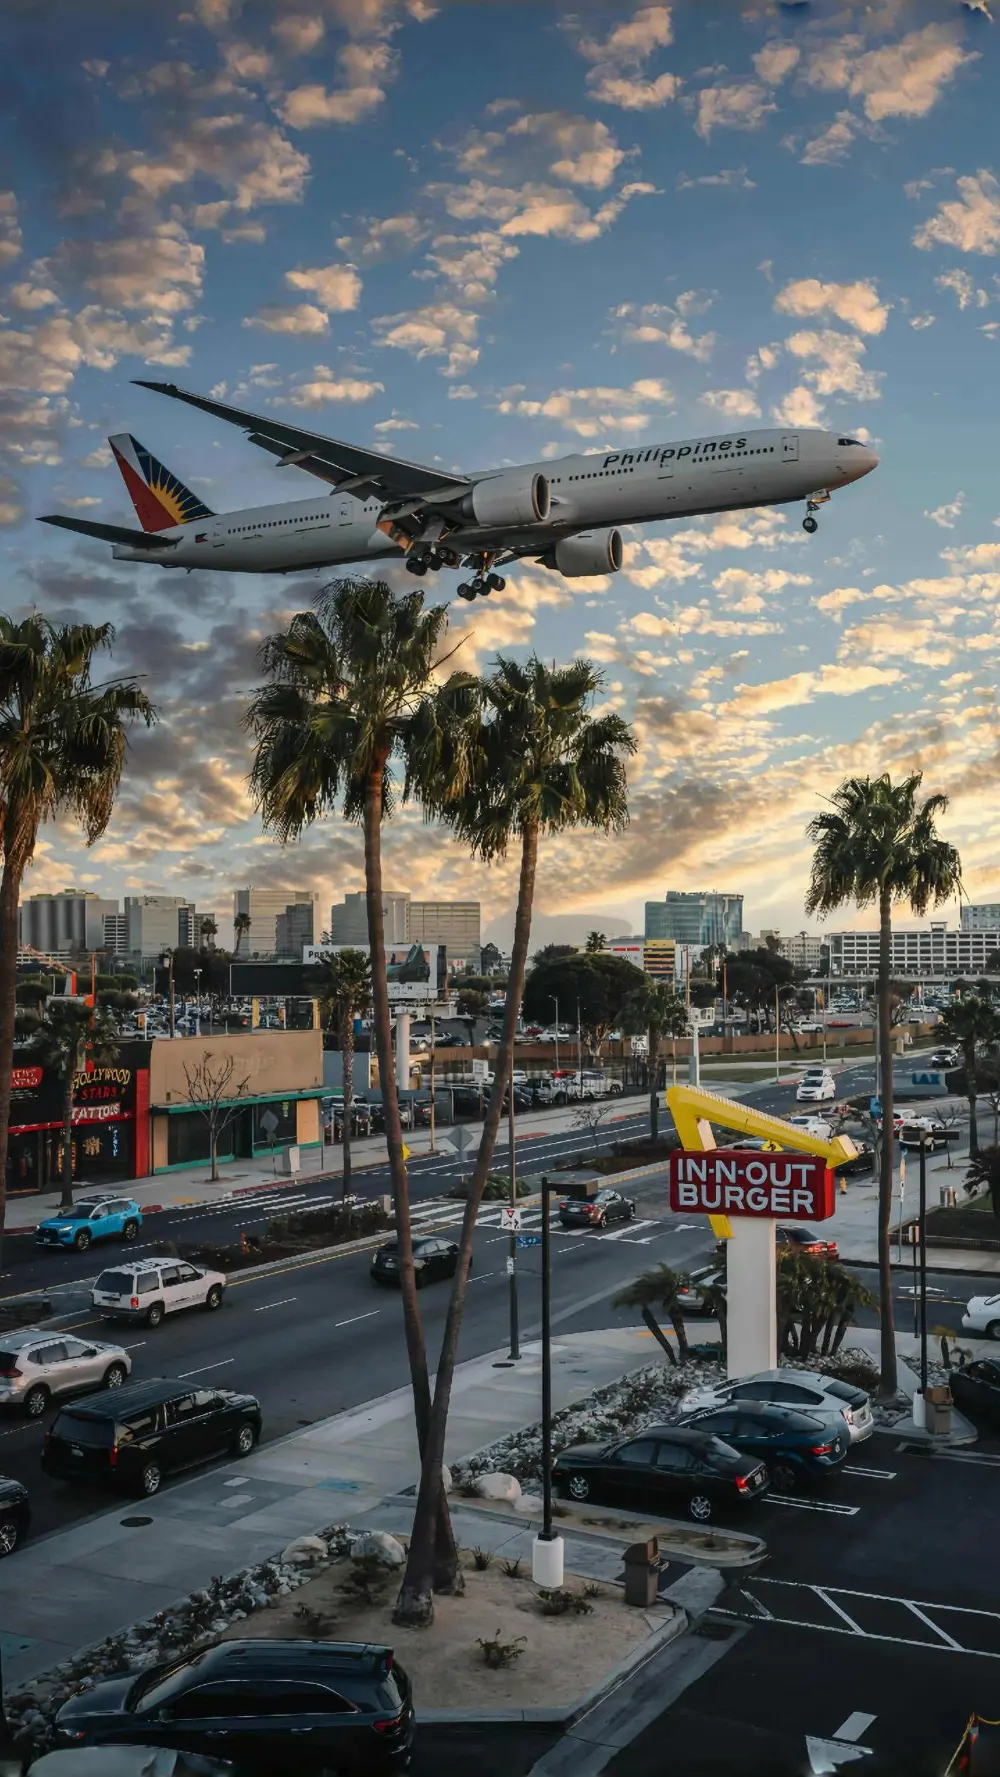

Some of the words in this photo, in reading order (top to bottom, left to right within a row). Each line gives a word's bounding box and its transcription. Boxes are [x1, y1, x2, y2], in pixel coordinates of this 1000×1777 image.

[602, 437, 747, 469] Philippines
[72, 1068, 131, 1089] HOLLYWOOD
[911, 1071, 940, 1085] LAX
[81, 1086, 117, 1100] STARS
[677, 1158, 816, 1188] IN-N-OUT
[678, 1182, 815, 1214] BURGER
